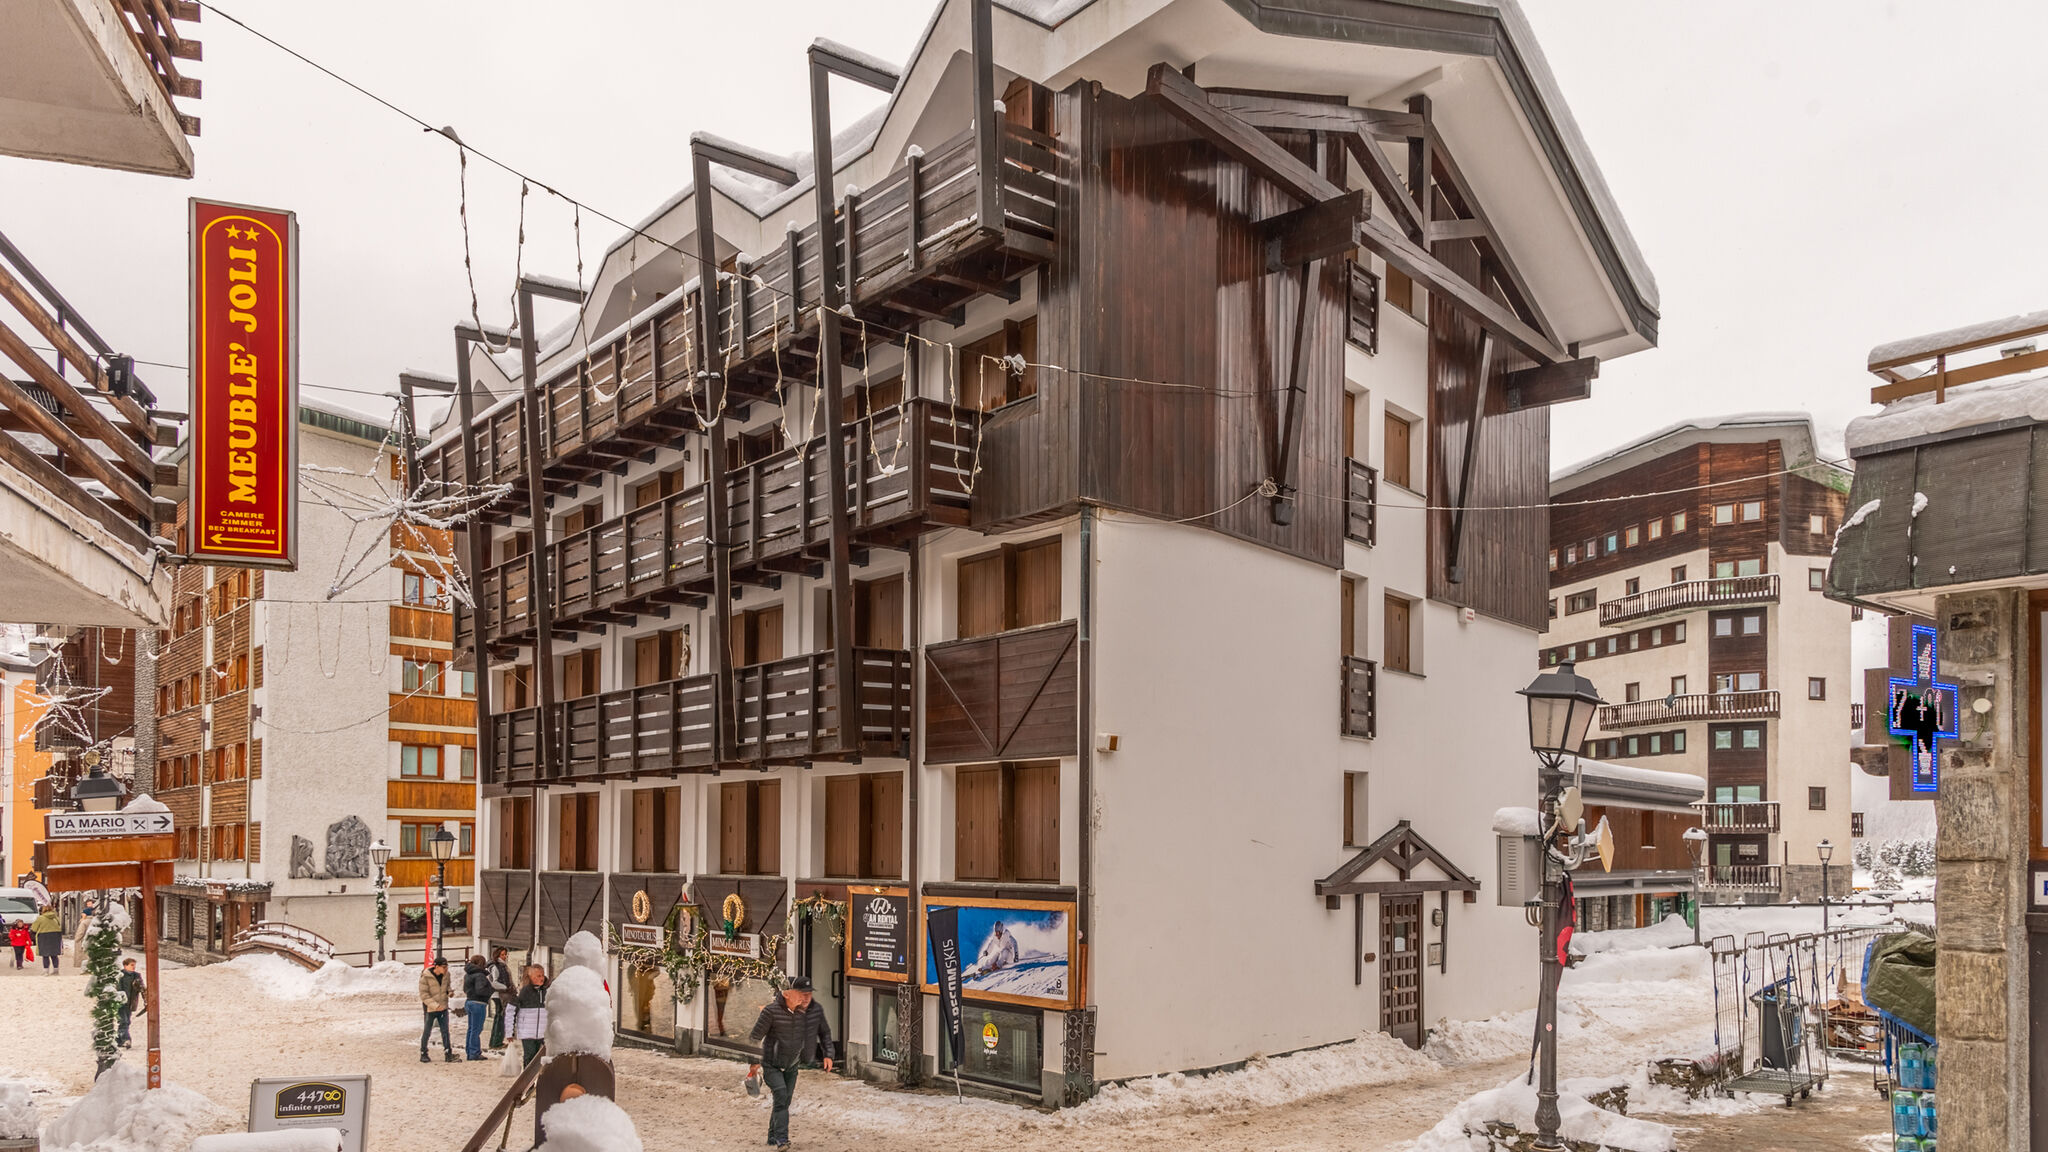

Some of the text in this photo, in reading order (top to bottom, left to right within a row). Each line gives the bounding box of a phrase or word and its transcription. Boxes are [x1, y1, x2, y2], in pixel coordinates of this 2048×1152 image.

[229, 246, 258, 504] MEUBLE' JOLI
[220, 510, 265, 520] CAMERE
[221, 518, 263, 527] ZIMMER
[227, 526, 276, 535] BREAKFAST
[55, 817, 125, 829] DA MARIO
[877, 914, 898, 925] RENTAL
[624, 928, 657, 942] MINOTAURUS
[712, 936, 751, 951] MINOTAURUS
[279, 1103, 341, 1113] infinite sports
